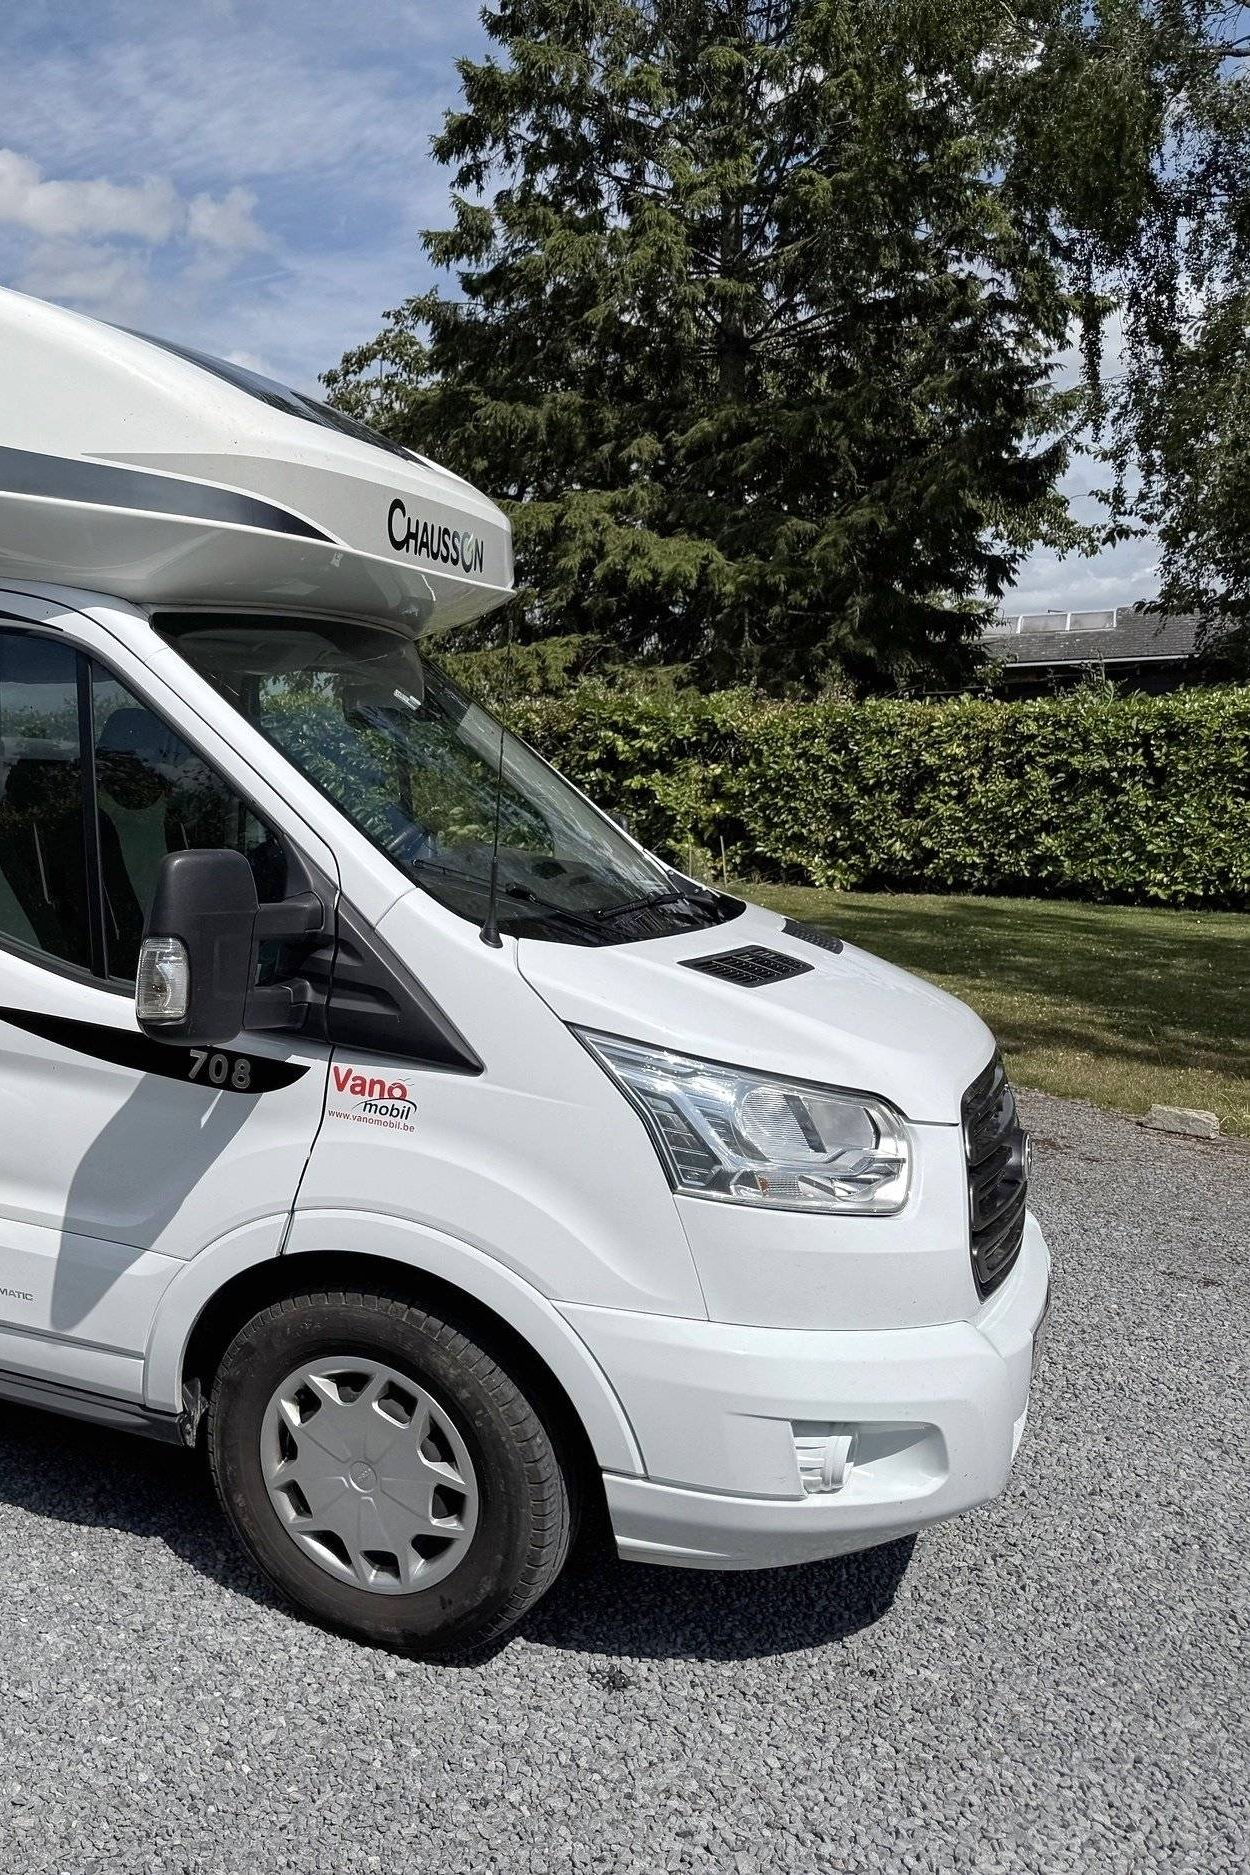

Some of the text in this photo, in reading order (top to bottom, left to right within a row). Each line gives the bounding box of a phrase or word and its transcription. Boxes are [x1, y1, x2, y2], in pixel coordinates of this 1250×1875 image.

[388, 499, 484, 573] CHAUSSON
[188, 1049, 251, 1089] 708
[333, 1066, 407, 1100] Vano
[328, 1109, 415, 1132] www.vanomobil.be
[362, 1102, 411, 1120] mobil
